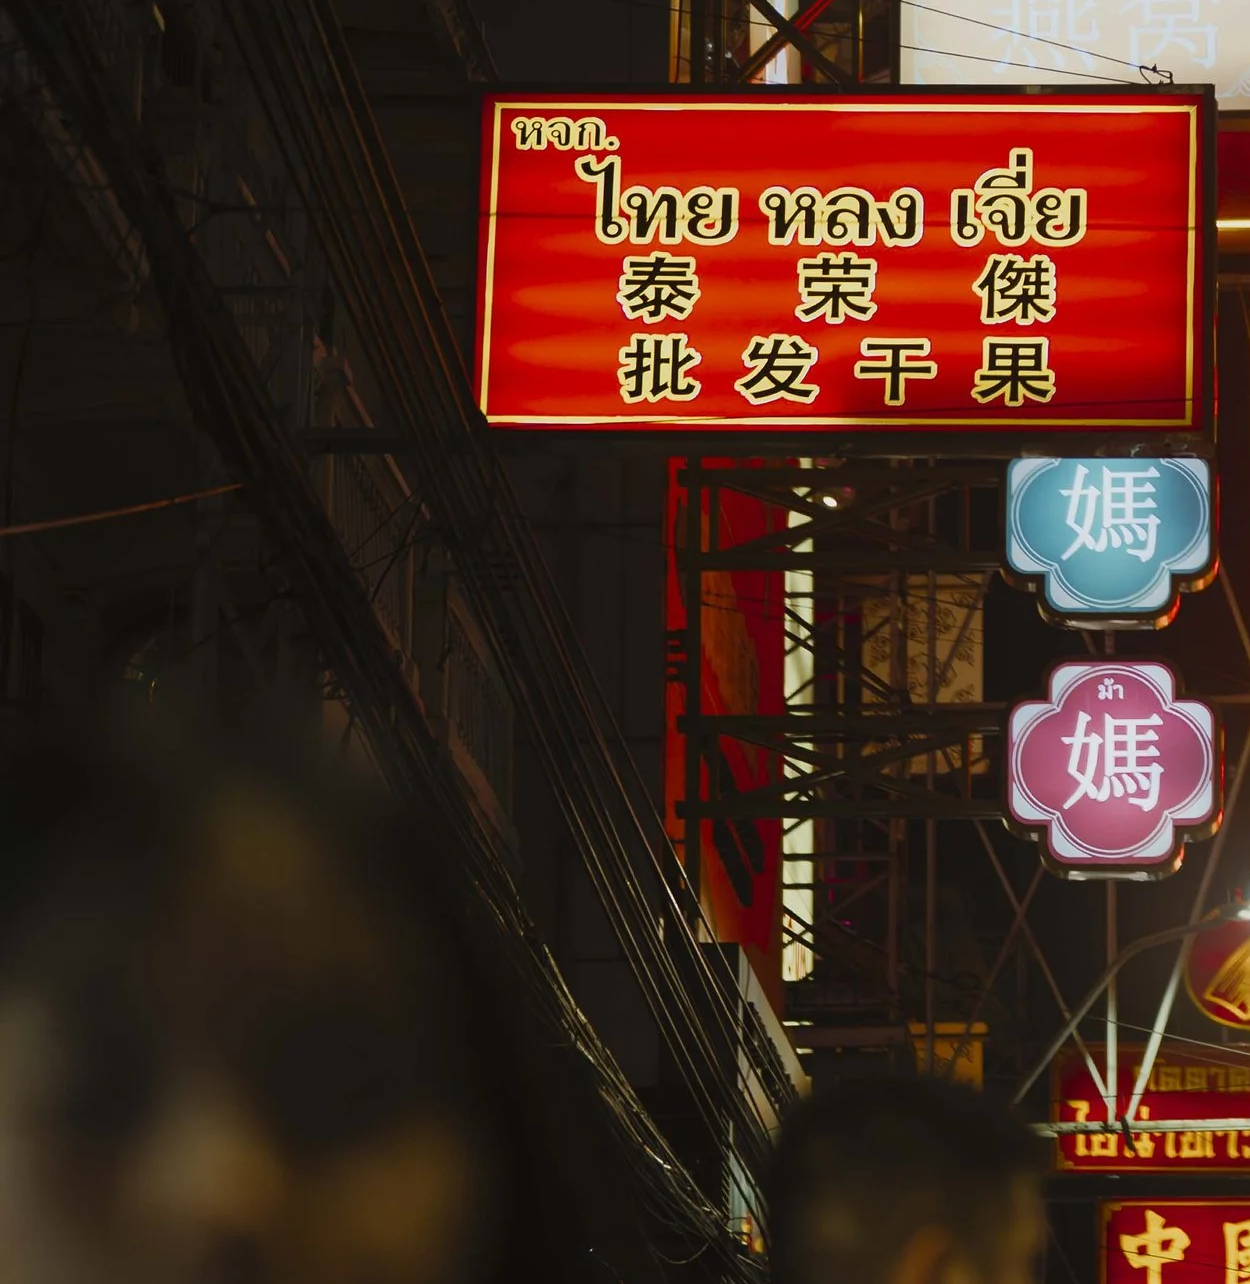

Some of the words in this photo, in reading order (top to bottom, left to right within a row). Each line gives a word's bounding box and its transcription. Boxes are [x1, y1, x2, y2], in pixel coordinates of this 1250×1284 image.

[511, 115, 620, 152] หจก.
[578, 154, 739, 246] ไทย
[760, 185, 924, 248] หลง
[950, 147, 1089, 247] เจี่ย
[618, 252, 1057, 324] 泰荣傑
[617, 333, 1056, 407] 批发干果
[1059, 463, 1161, 563] 媽
[1097, 676, 1125, 701] ม้า
[1060, 710, 1165, 813] 媽
